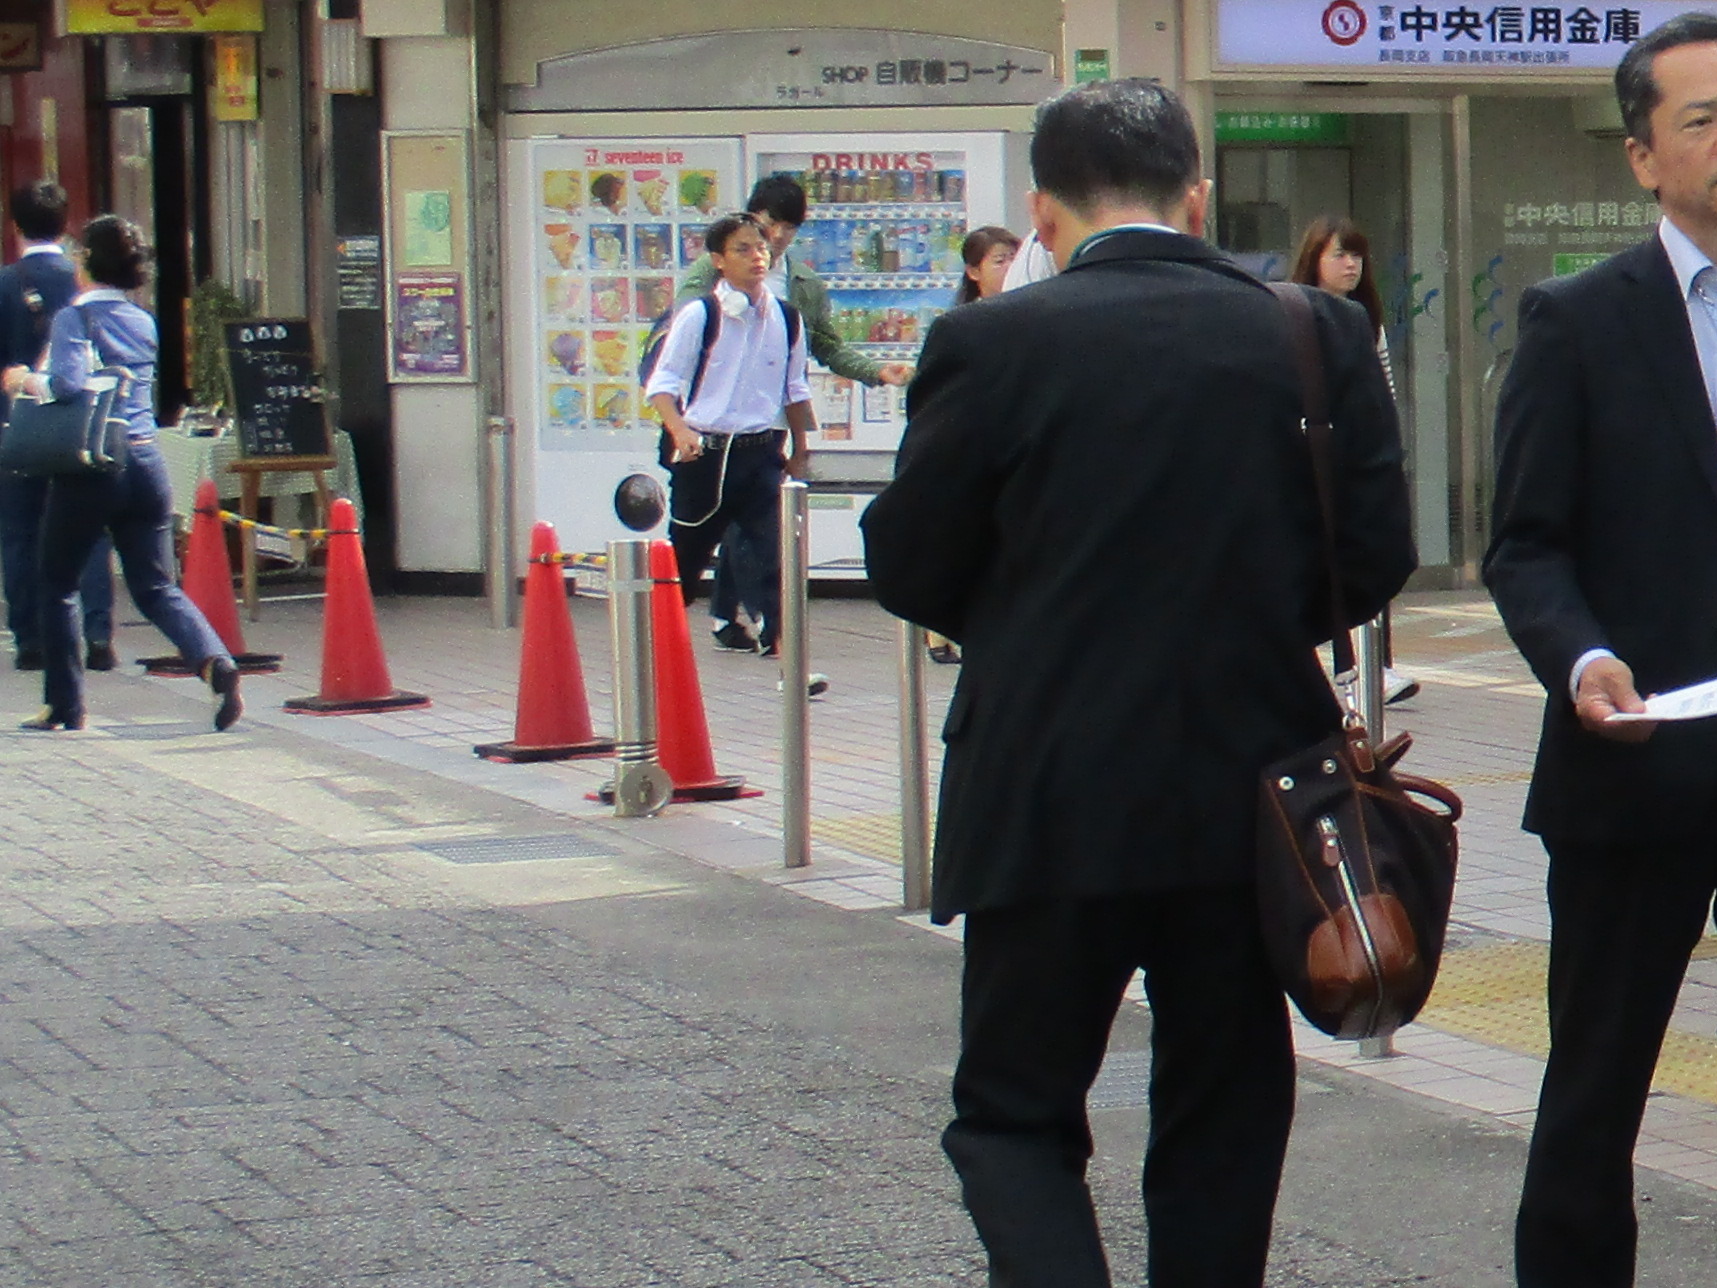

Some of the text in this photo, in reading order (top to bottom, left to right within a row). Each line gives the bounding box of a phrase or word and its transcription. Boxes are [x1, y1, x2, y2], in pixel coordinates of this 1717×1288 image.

[1399, 4, 1642, 45] 中央信用金庫
[821, 59, 1043, 86] SHOP 自販機コーナー
[604, 150, 664, 164] seventeen
[666, 147, 684, 165] ice
[812, 151, 935, 172] DRINKS
